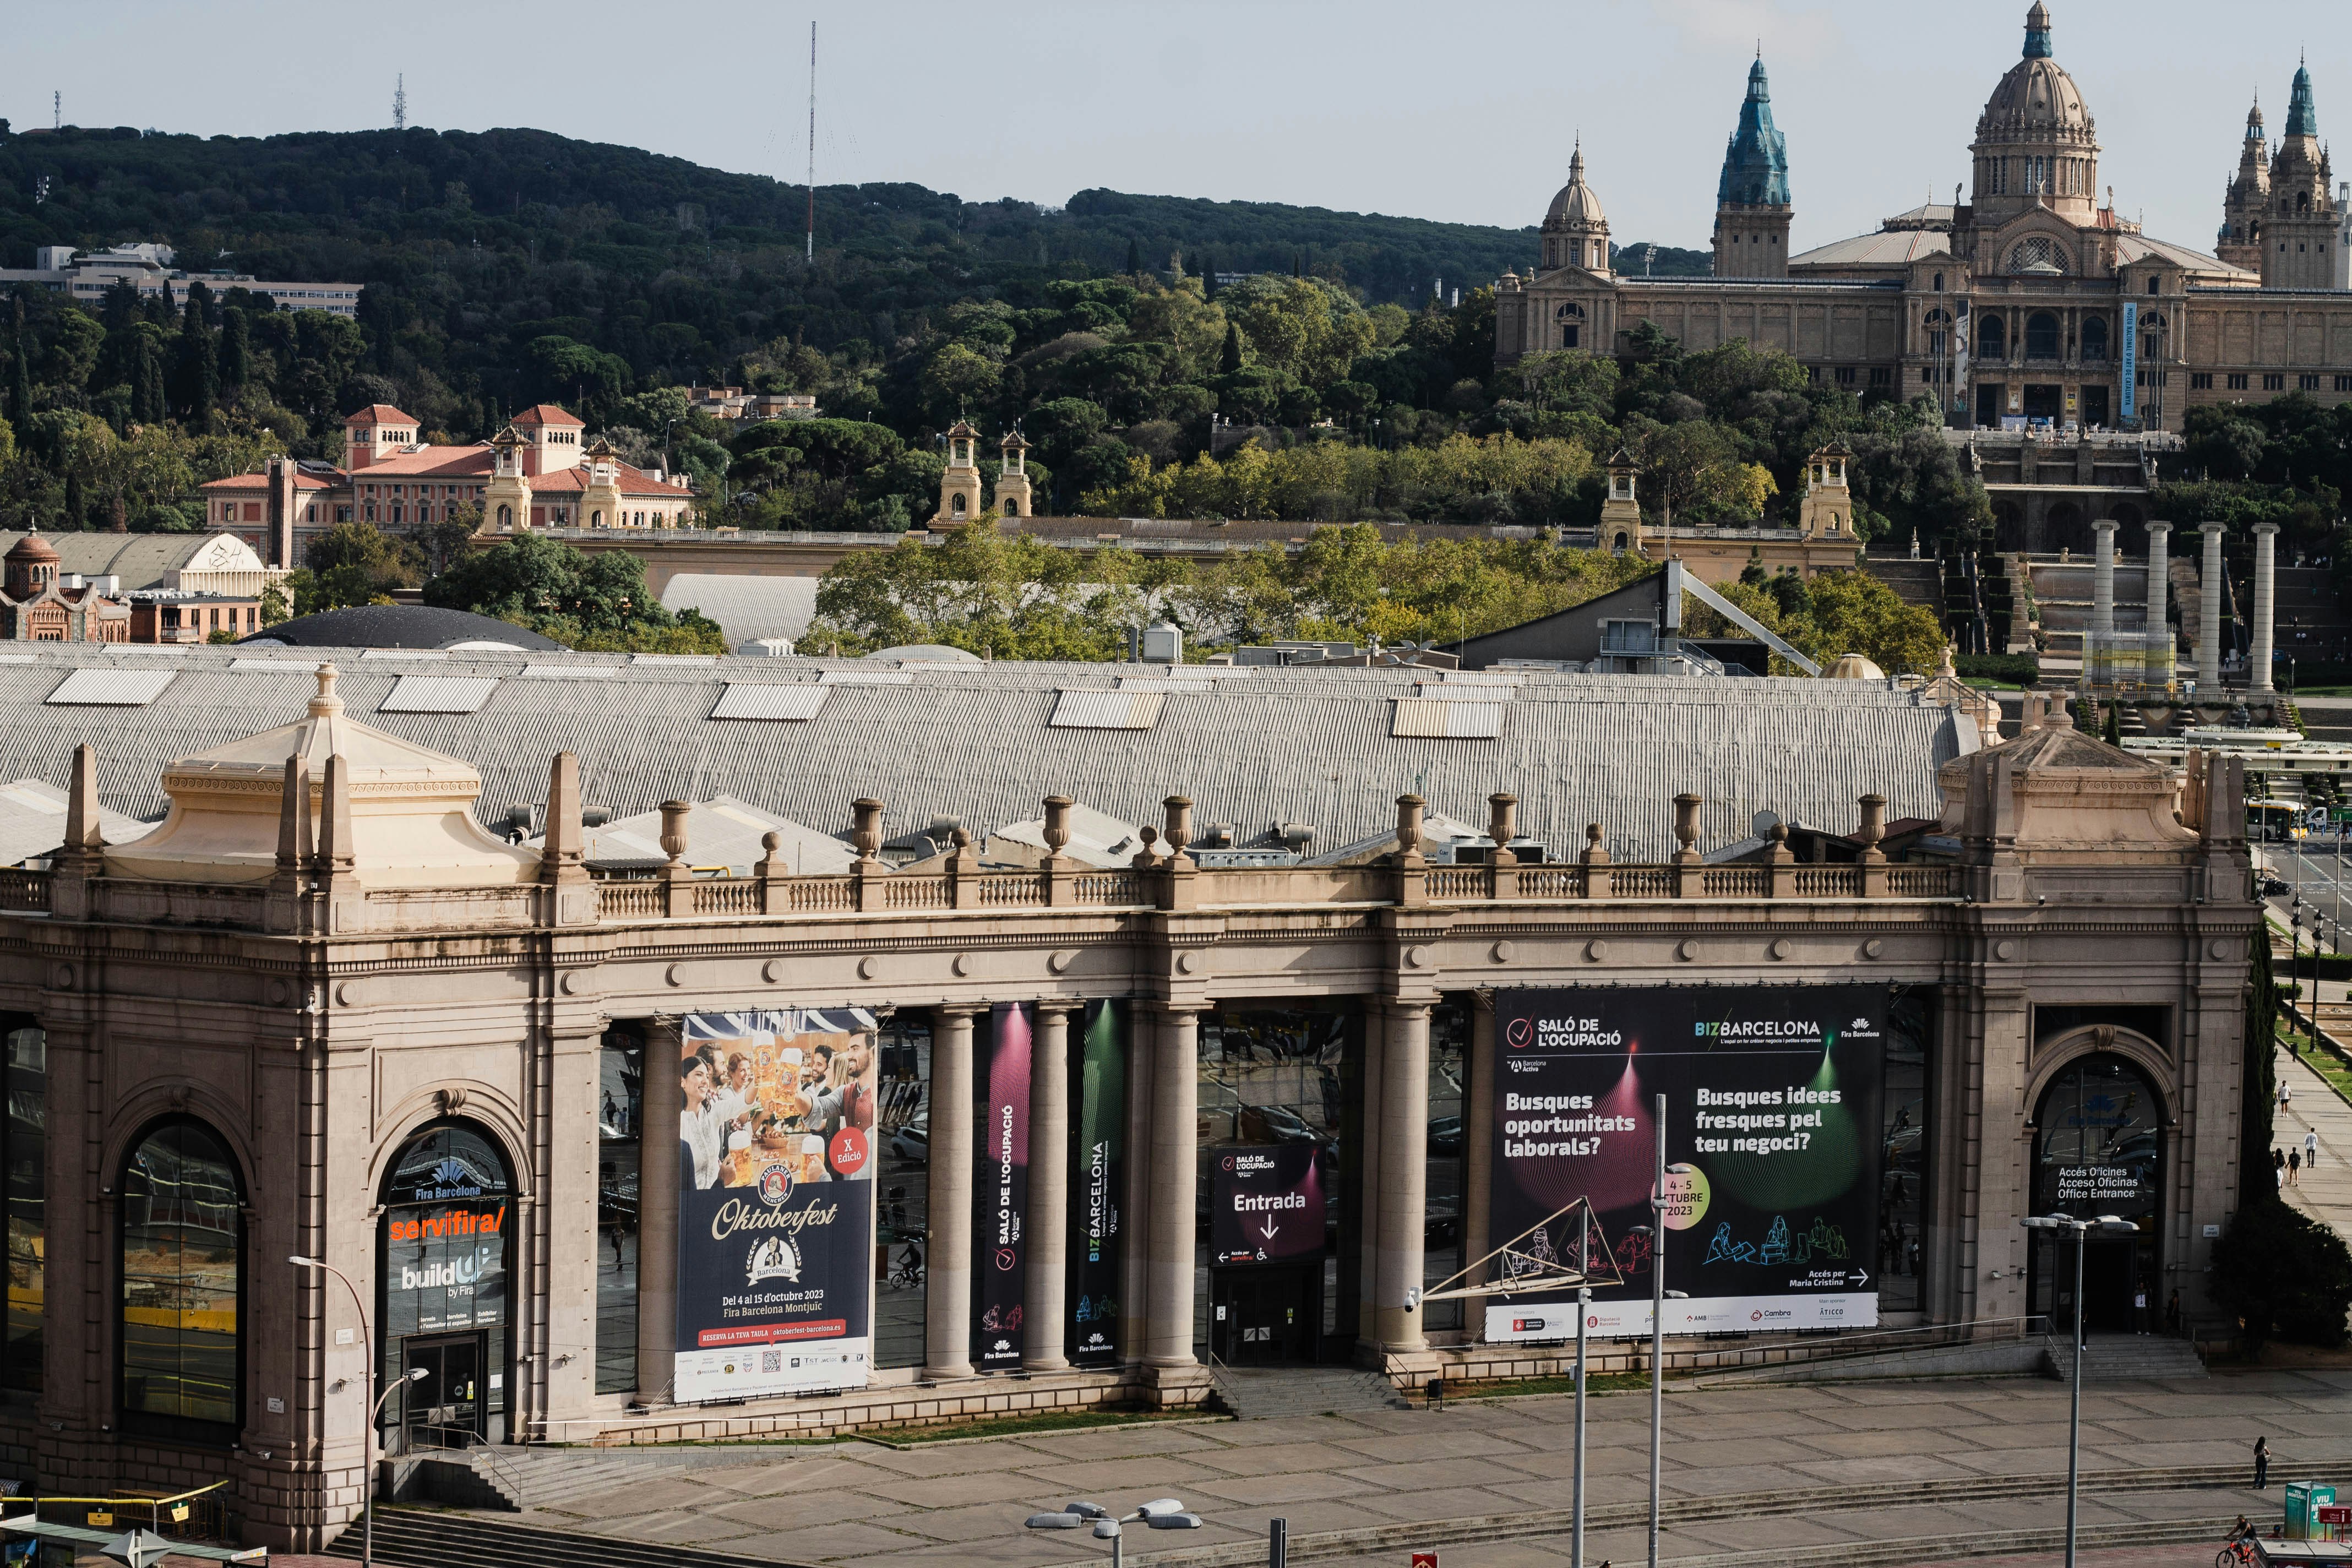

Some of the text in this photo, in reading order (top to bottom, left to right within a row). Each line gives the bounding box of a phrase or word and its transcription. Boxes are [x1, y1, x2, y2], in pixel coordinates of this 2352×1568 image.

[1538, 1016, 1599, 1032] SALÓ DE
[1538, 1030, 1621, 1047] L'OCUPACIÓ
[1506, 1093, 1593, 1114] Busques
[1697, 1086, 1841, 1109] Busques idees
[1505, 1114, 1636, 1137] oportunitats
[1696, 1109, 1822, 1132] fresques pel
[843, 1139, 853, 1152] X
[1505, 1137, 1601, 1157] laborals?
[1695, 1133, 1811, 1155] teu negoci?
[837, 1150, 862, 1164] Edició
[1237, 1155, 1254, 1163] SALÓ
[1237, 1160, 1275, 1170] L'OCUPACIÓ
[2059, 1167, 2087, 1177] Accés
[761, 1164, 791, 1182] PAULANER
[998, 1105, 1013, 1245] SALÓ DE L'OCUPACIÓ
[1670, 1181, 1676, 1190] 4
[1686, 1180, 1692, 1190] 5
[2059, 1177, 2138, 1188] Acceso Oficinas
[416, 1185, 481, 1200] Fira Barcelona
[763, 1193, 788, 1204] MÜNCHEN
[2058, 1189, 2135, 1199] Office Entrance
[1234, 1191, 1305, 1212] Entrada
[1668, 1206, 1692, 1216] 2023
[712, 1197, 838, 1240] Oktoberfest
[757, 1267, 791, 1277] Barcelona
[1809, 1270, 1831, 1278] Accés
[448, 1286, 475, 1299] by Fira
[722, 1289, 824, 1306] Del 4 al 15 d'octubre 2023
[723, 1301, 822, 1318] Fira Barcelona Montjuïc
[703, 1332, 727, 1342] RESERVA
[2316, 1495, 2330, 1504] VIU
